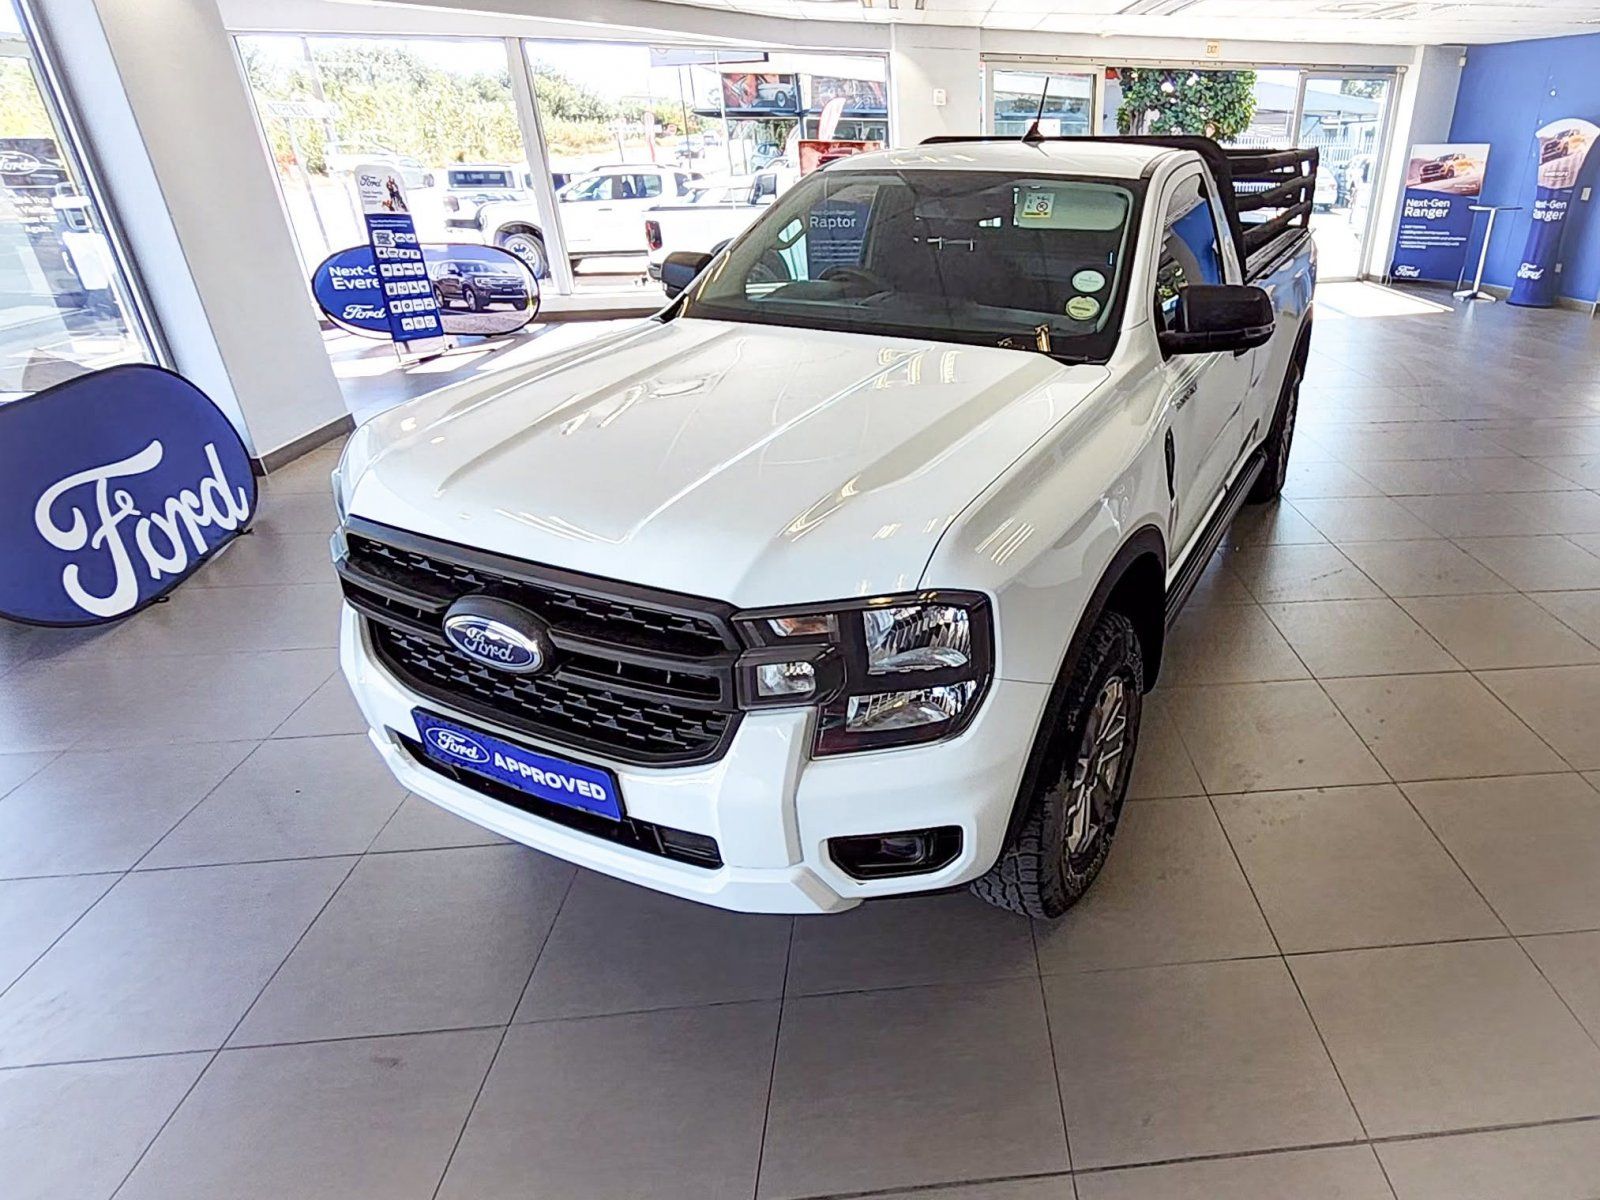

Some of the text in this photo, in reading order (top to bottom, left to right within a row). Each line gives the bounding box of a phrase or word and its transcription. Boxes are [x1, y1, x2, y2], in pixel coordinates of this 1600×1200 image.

[360, 175, 382, 187] Ford
[1406, 199, 1451, 208] Next-Gen
[1404, 208, 1449, 219] Ranger
[809, 216, 856, 230] Raptor
[328, 265, 377, 277] Next-G
[1394, 265, 1420, 277] Ford
[1517, 262, 1544, 280] Ford
[332, 277, 381, 290] Evere
[343, 304, 386, 319] Ford
[35, 439, 250, 618] Ford
[463, 627, 515, 663] Ford
[437, 731, 607, 802] Ford APPROVED
